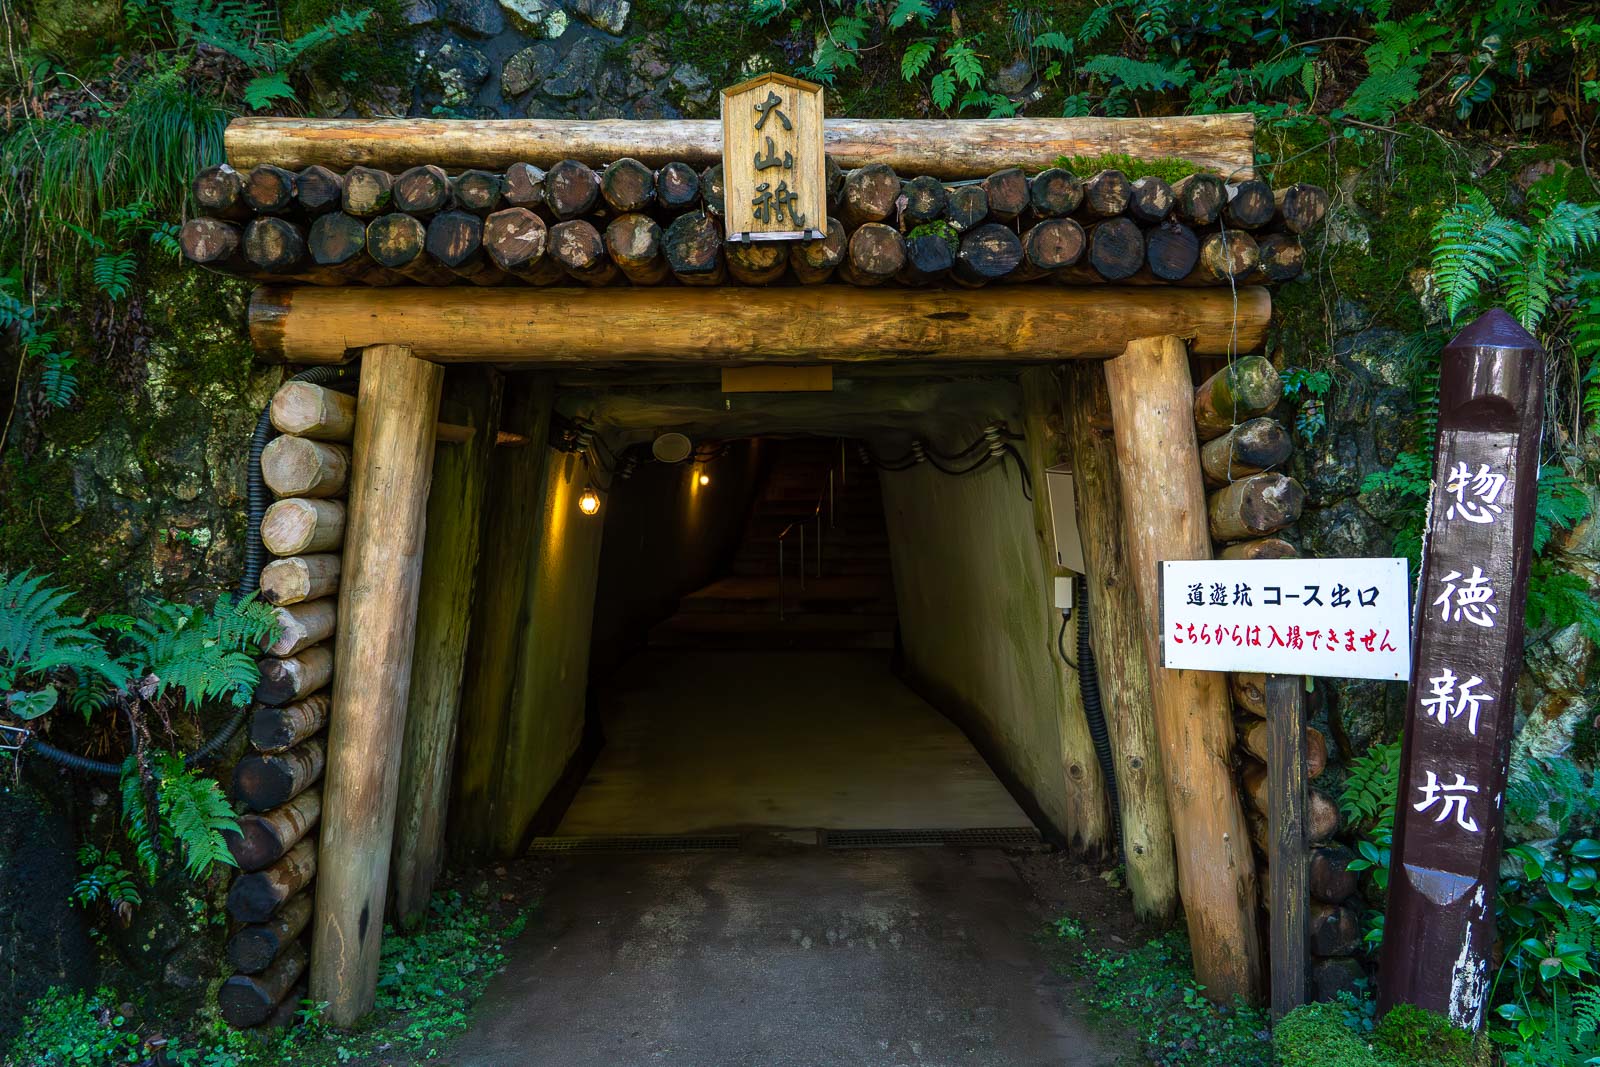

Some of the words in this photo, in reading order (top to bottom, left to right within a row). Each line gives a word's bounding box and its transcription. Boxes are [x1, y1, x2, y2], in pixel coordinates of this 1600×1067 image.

[1173, 622, 1397, 653] こちらからは入場できません
[1413, 461, 1506, 832] 惣徳新坑
